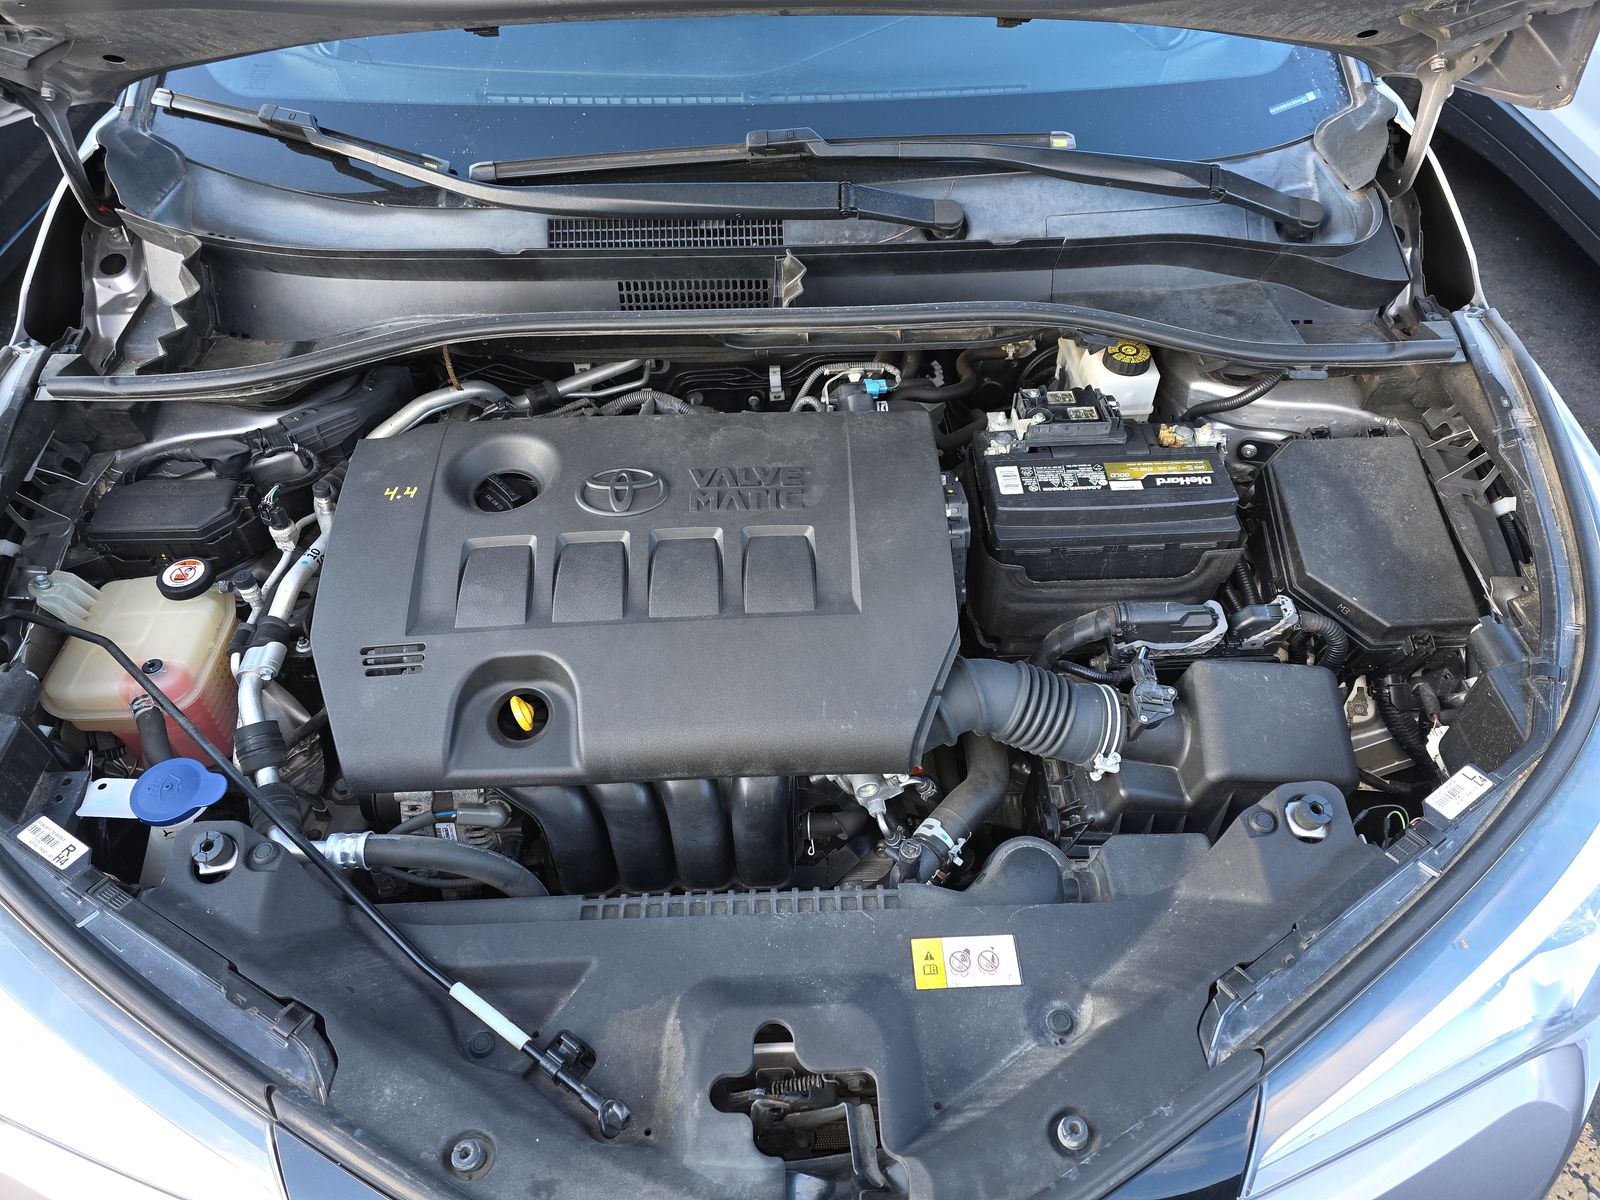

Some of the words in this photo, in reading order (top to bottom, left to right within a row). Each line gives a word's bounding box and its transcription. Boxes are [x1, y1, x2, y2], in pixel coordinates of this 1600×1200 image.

[688, 466, 804, 488] VALVE
[1155, 475, 1212, 486] DieHard
[384, 486, 418, 501] 4.4
[688, 488, 804, 512] MATIC
[306, 548, 321, 560] 10
[61, 843, 77, 857] R
